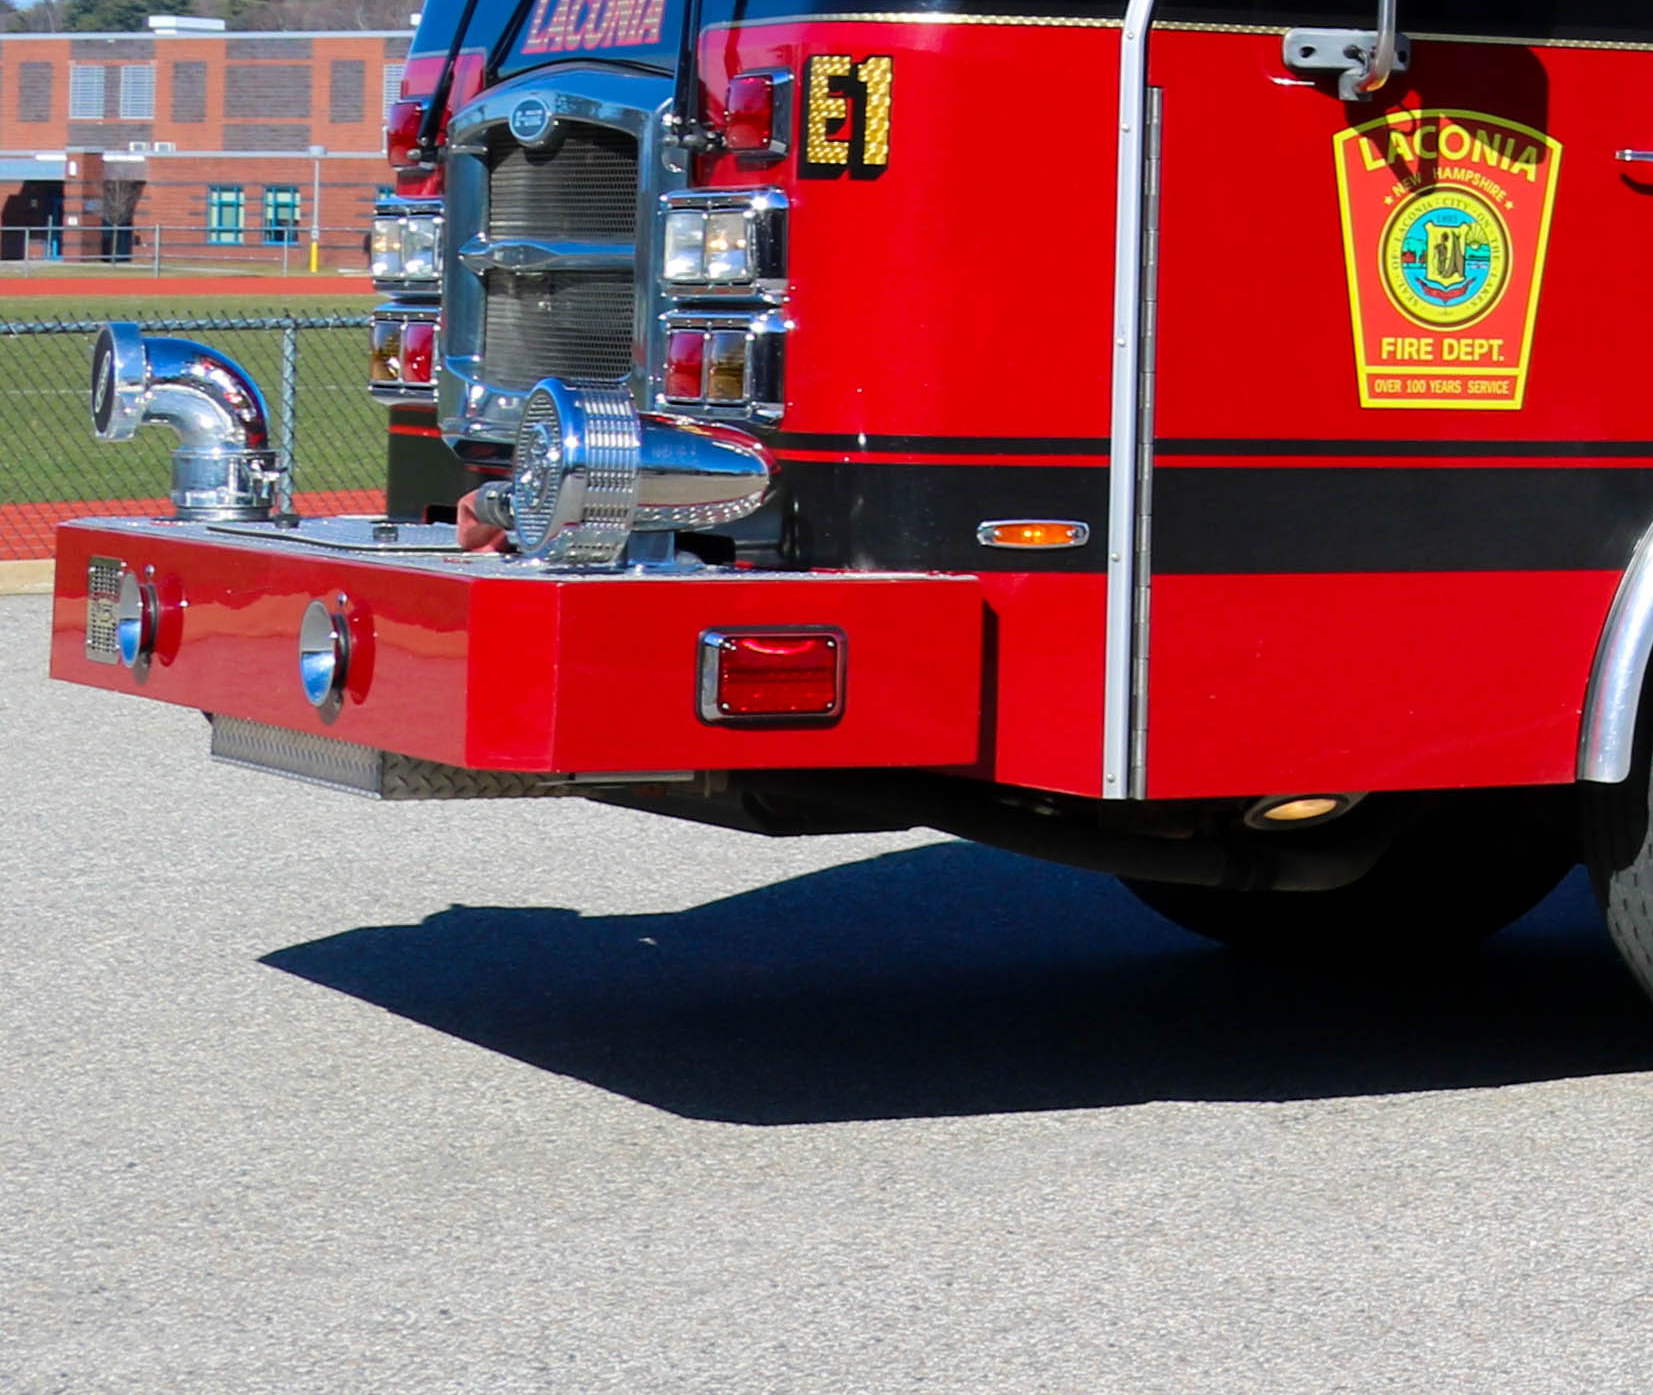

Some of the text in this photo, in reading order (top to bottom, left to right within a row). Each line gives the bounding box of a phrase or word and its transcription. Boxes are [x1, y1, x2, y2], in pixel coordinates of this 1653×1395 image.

[804, 55, 892, 169] E1
[1358, 124, 1538, 182] LACONIA
[1391, 167, 1507, 203] NEW HAMPSHIRE
[1381, 337, 1505, 362] FIRE DEPT.
[1374, 379, 1510, 395] OVER 100 YEARS SERVICE
